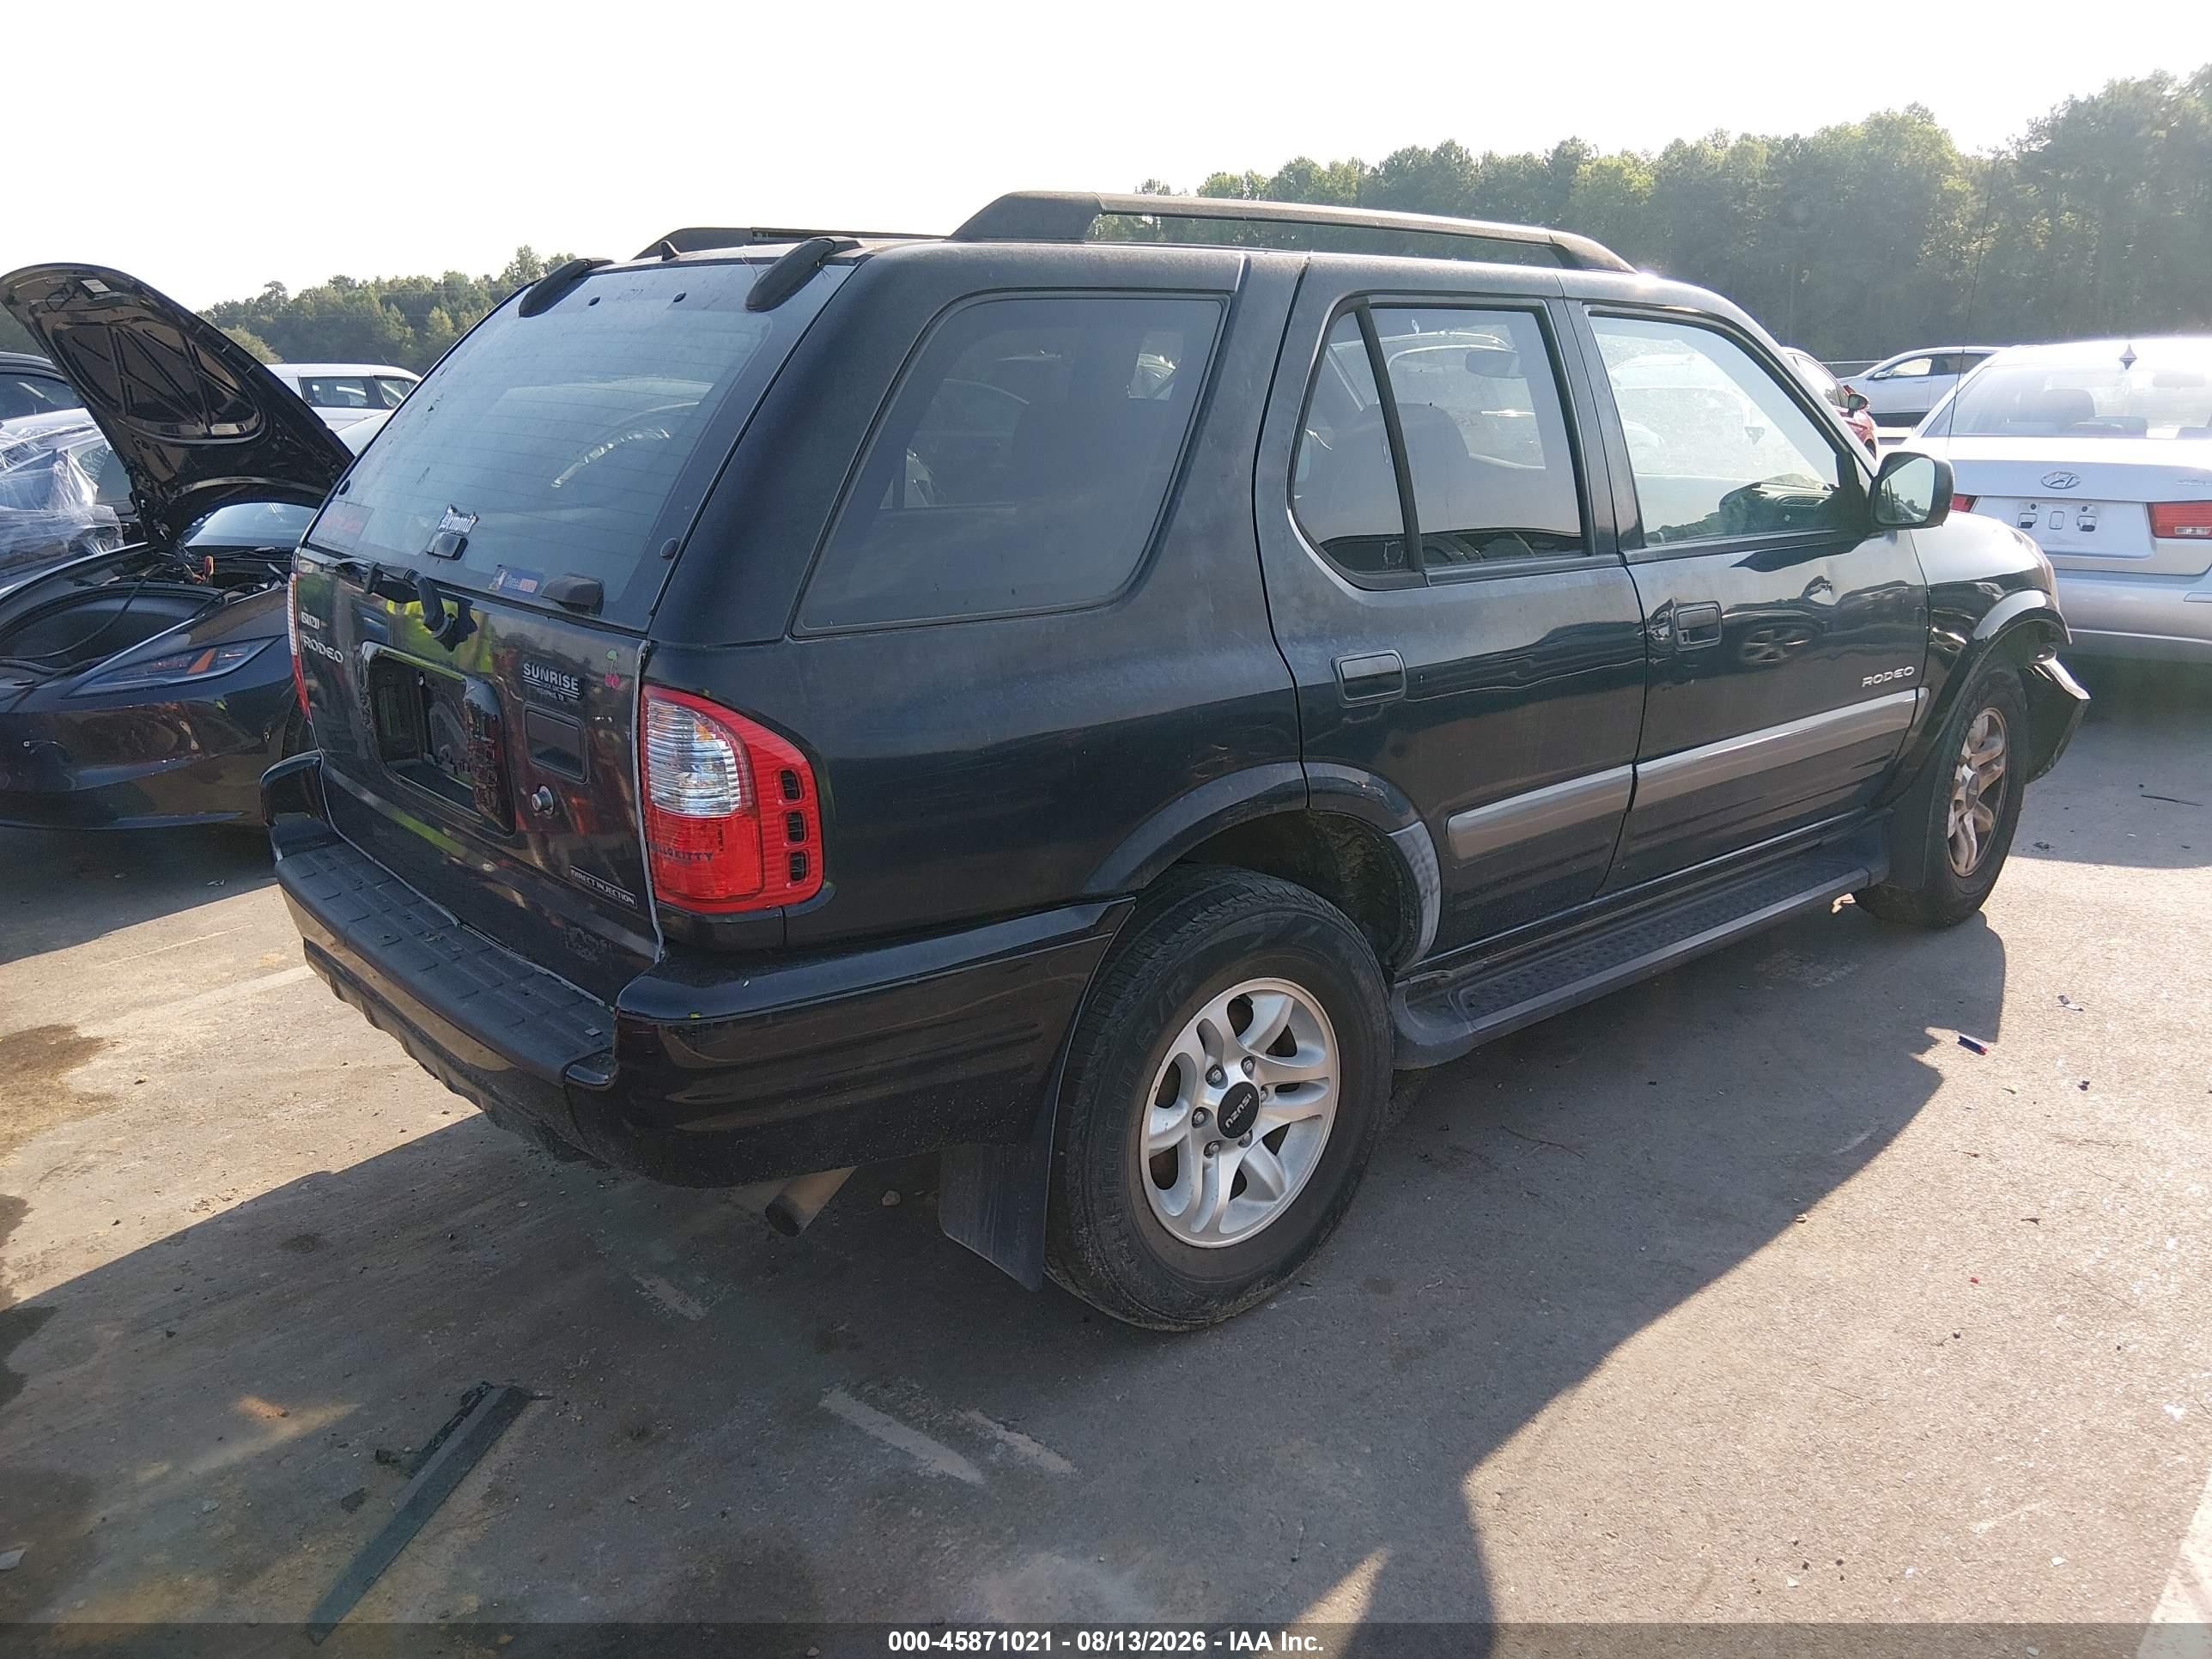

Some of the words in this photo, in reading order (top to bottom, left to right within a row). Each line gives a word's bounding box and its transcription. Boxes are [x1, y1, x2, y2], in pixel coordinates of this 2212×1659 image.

[302, 635, 344, 663] RODEO
[523, 663, 579, 691] SUNRISE
[1862, 666, 1915, 688] RODEO
[570, 869, 596, 886] DIRECT
[596, 881, 635, 905] INJECTION
[1224, 1093, 1252, 1128] ISUZU
